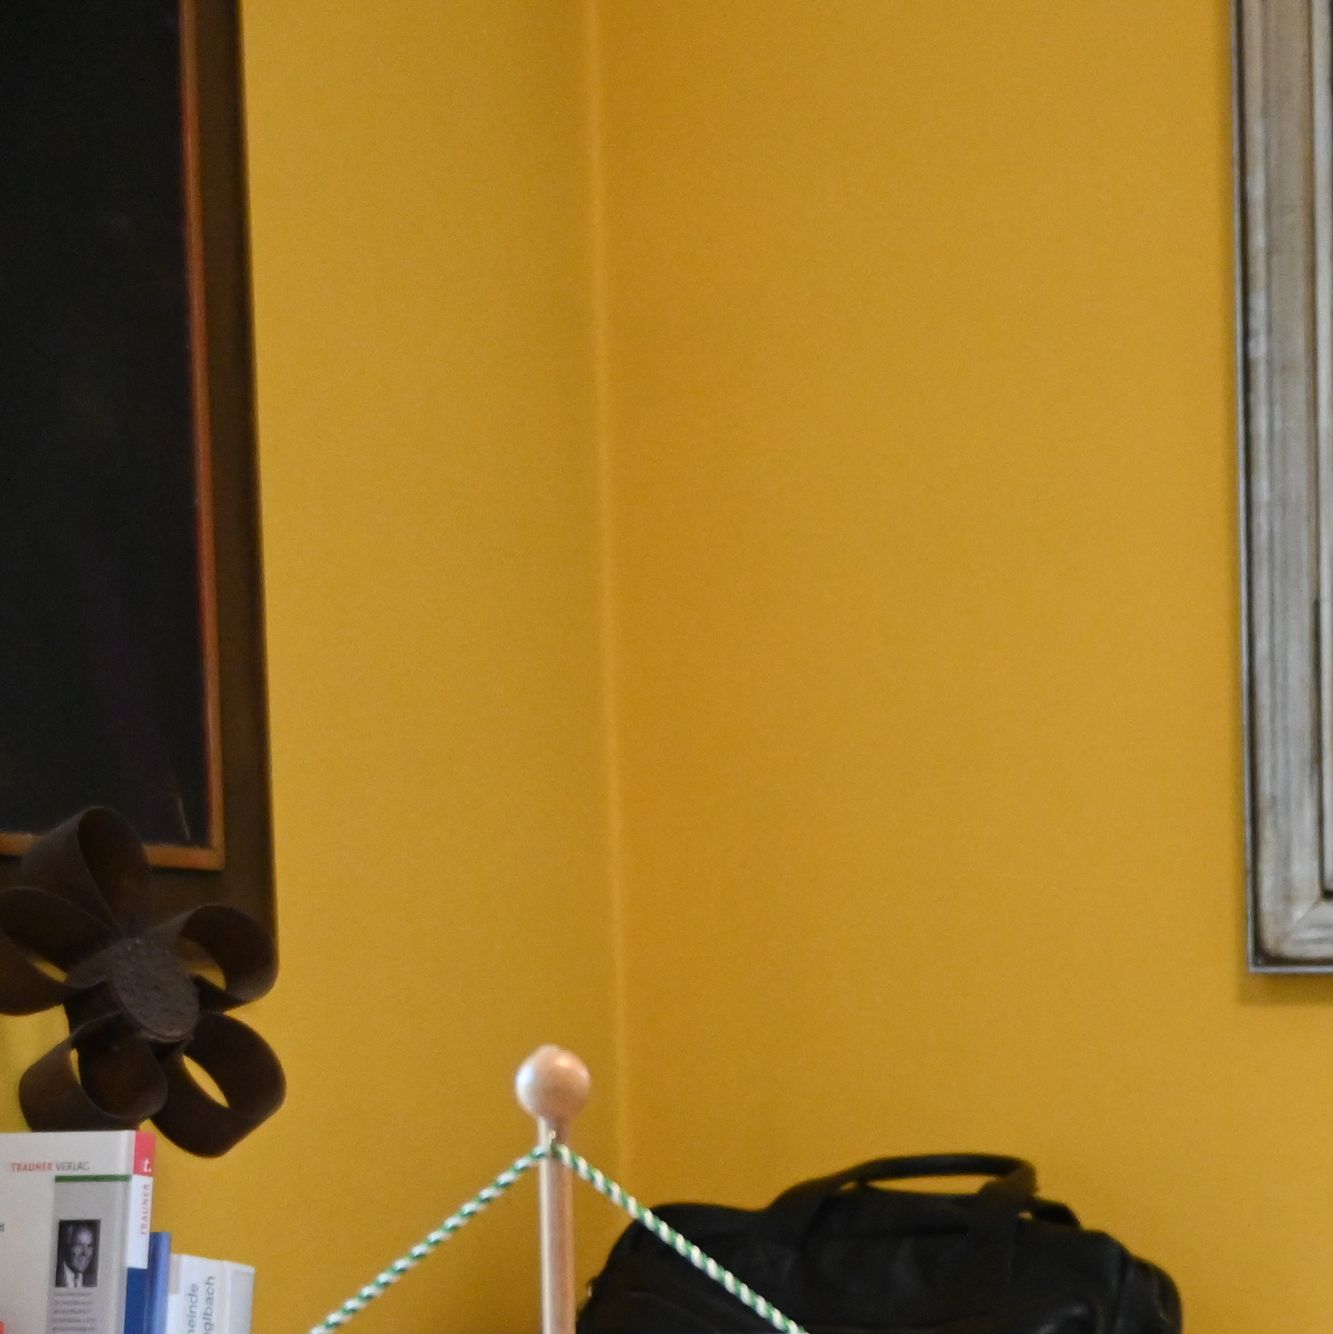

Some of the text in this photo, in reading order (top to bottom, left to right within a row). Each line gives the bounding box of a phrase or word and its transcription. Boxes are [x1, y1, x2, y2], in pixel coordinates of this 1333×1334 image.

[11, 1161, 91, 1172] TRAUNER VERLAG
[140, 1183, 150, 1235] TRAUNER
